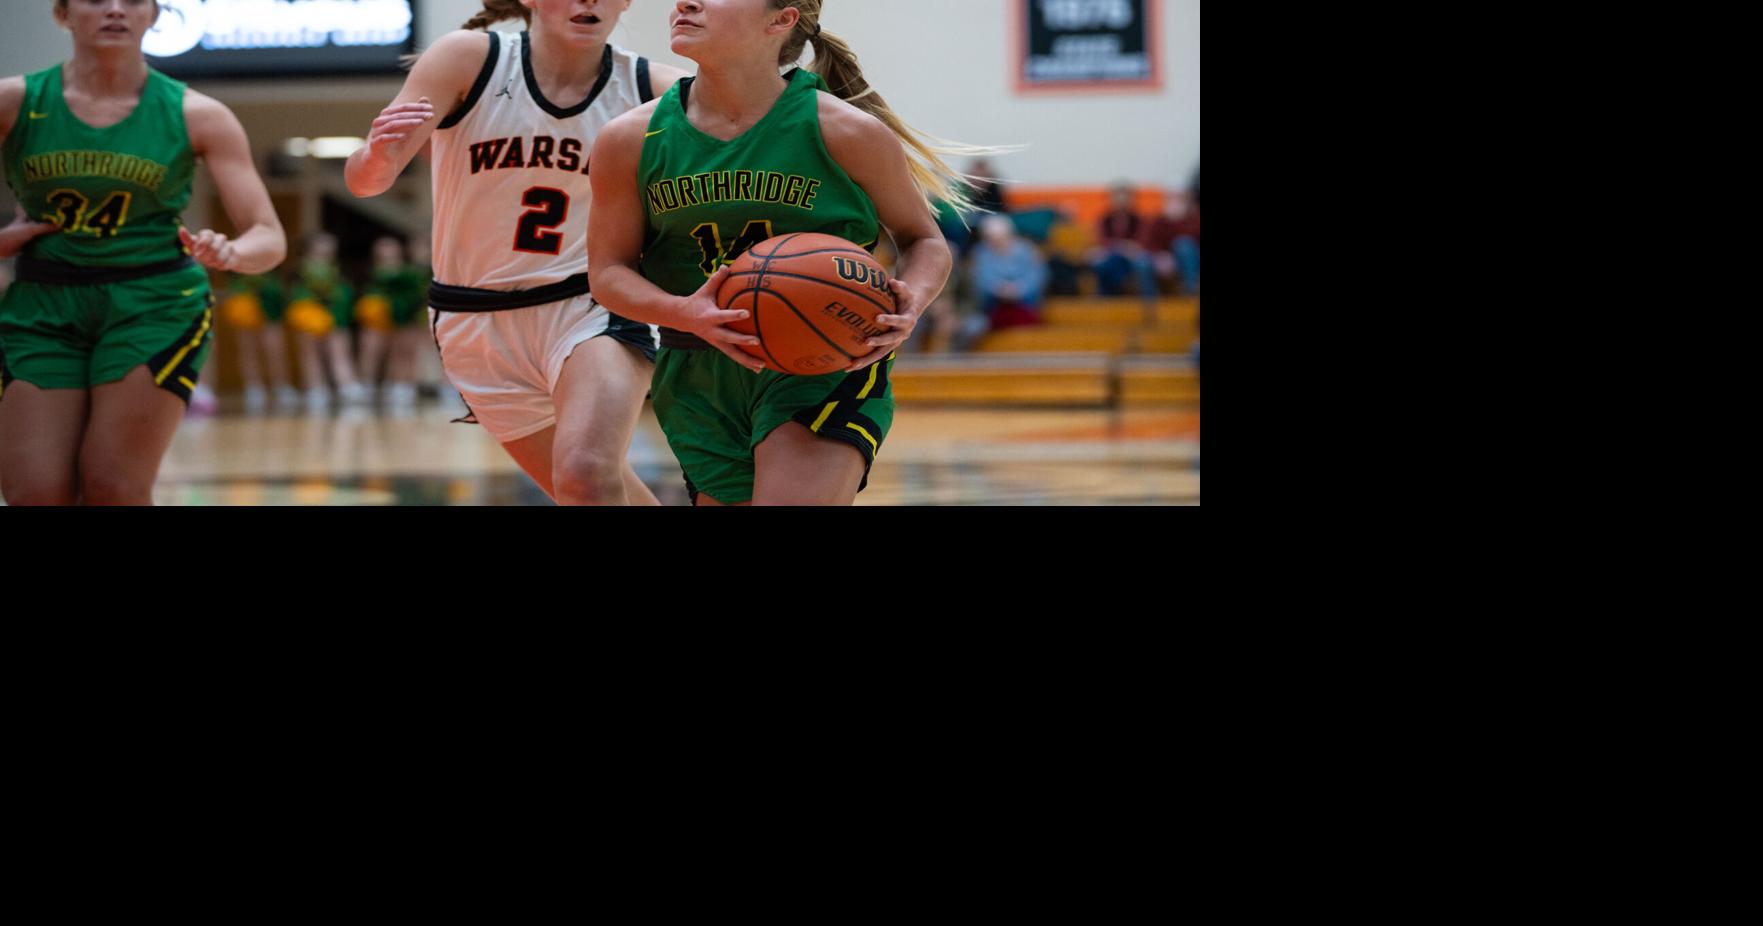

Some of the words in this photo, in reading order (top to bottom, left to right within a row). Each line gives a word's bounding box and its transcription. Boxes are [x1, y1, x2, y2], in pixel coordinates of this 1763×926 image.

[23, 150, 169, 191] NORTHRIDGE
[469, 135, 591, 176] WARS
[42, 188, 132, 238] 34
[647, 170, 820, 214] NORTHRIDGE
[512, 186, 570, 255] 2
[832, 256, 896, 298] Wil
